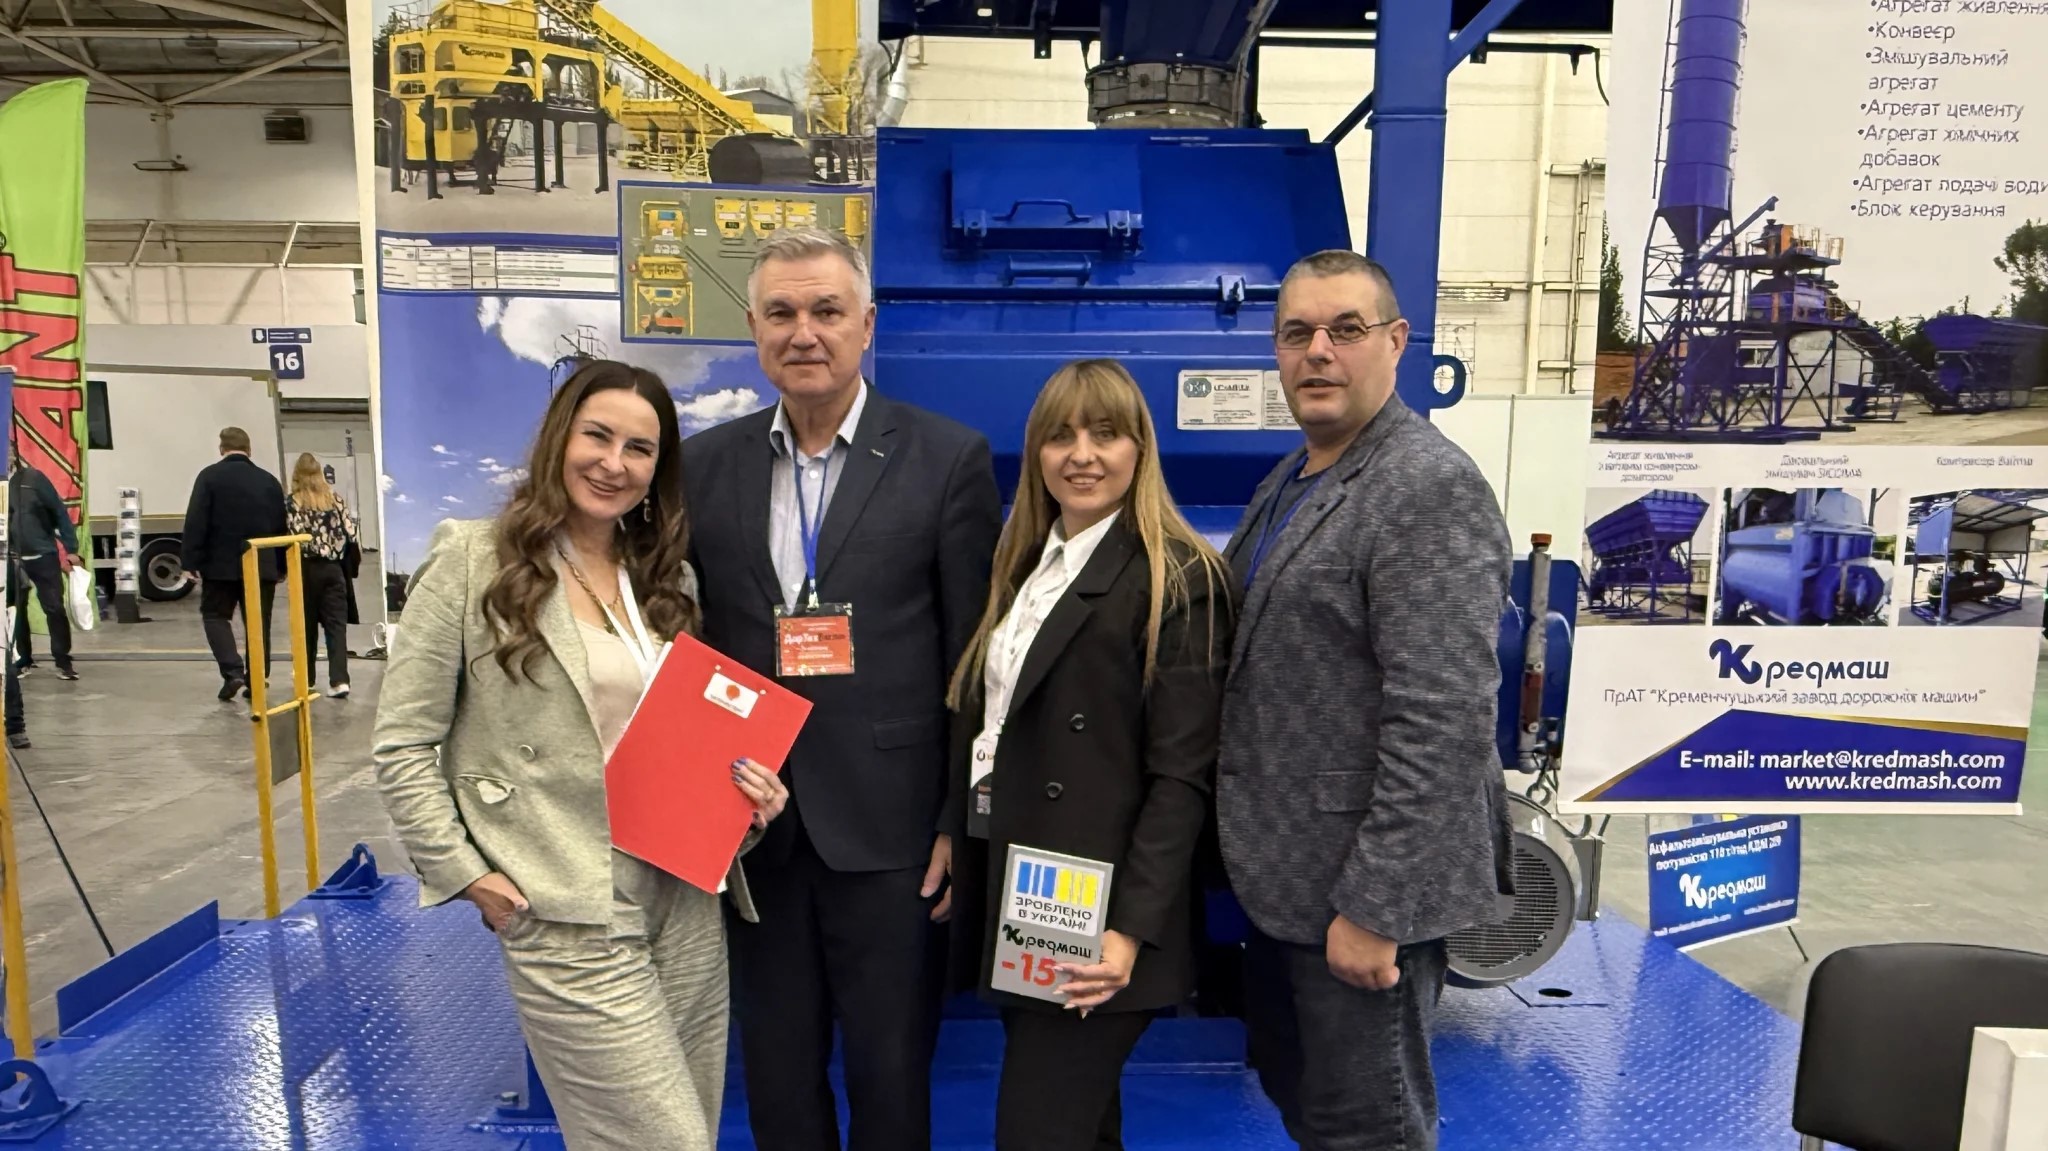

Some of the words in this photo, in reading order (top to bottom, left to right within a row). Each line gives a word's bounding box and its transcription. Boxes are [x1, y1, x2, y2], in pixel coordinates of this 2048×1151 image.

[1870, 46, 2009, 70] Змішувальний
[1868, 76, 1939, 94] агрегат
[1866, 99, 1940, 120] Агрегат
[1947, 103, 2025, 123] цементу
[1863, 124, 1938, 146] Агрегат
[1859, 148, 1942, 170] добавок
[1858, 174, 1933, 196] Агрегат
[1938, 177, 1999, 195] подачі
[1857, 199, 1902, 218] Блок
[1908, 204, 2006, 221] керування
[274, 351, 300, 371] 16
[1709, 638, 1890, 689] Кредмаш
[1604, 688, 1646, 706] ПрАТ
[1792, 692, 1838, 706] завод
[1680, 750, 1755, 769] E-mail:
[1759, 749, 2006, 769] market@kredmash.com
[1785, 770, 2003, 790] www.kredmash.com
[1679, 873, 1767, 909] Кредмаш
[1015, 896, 1092, 921] ЗРОБЛЕНО
[1018, 909, 1027, 918] В
[1002, 923, 1092, 959] Кредмаш
